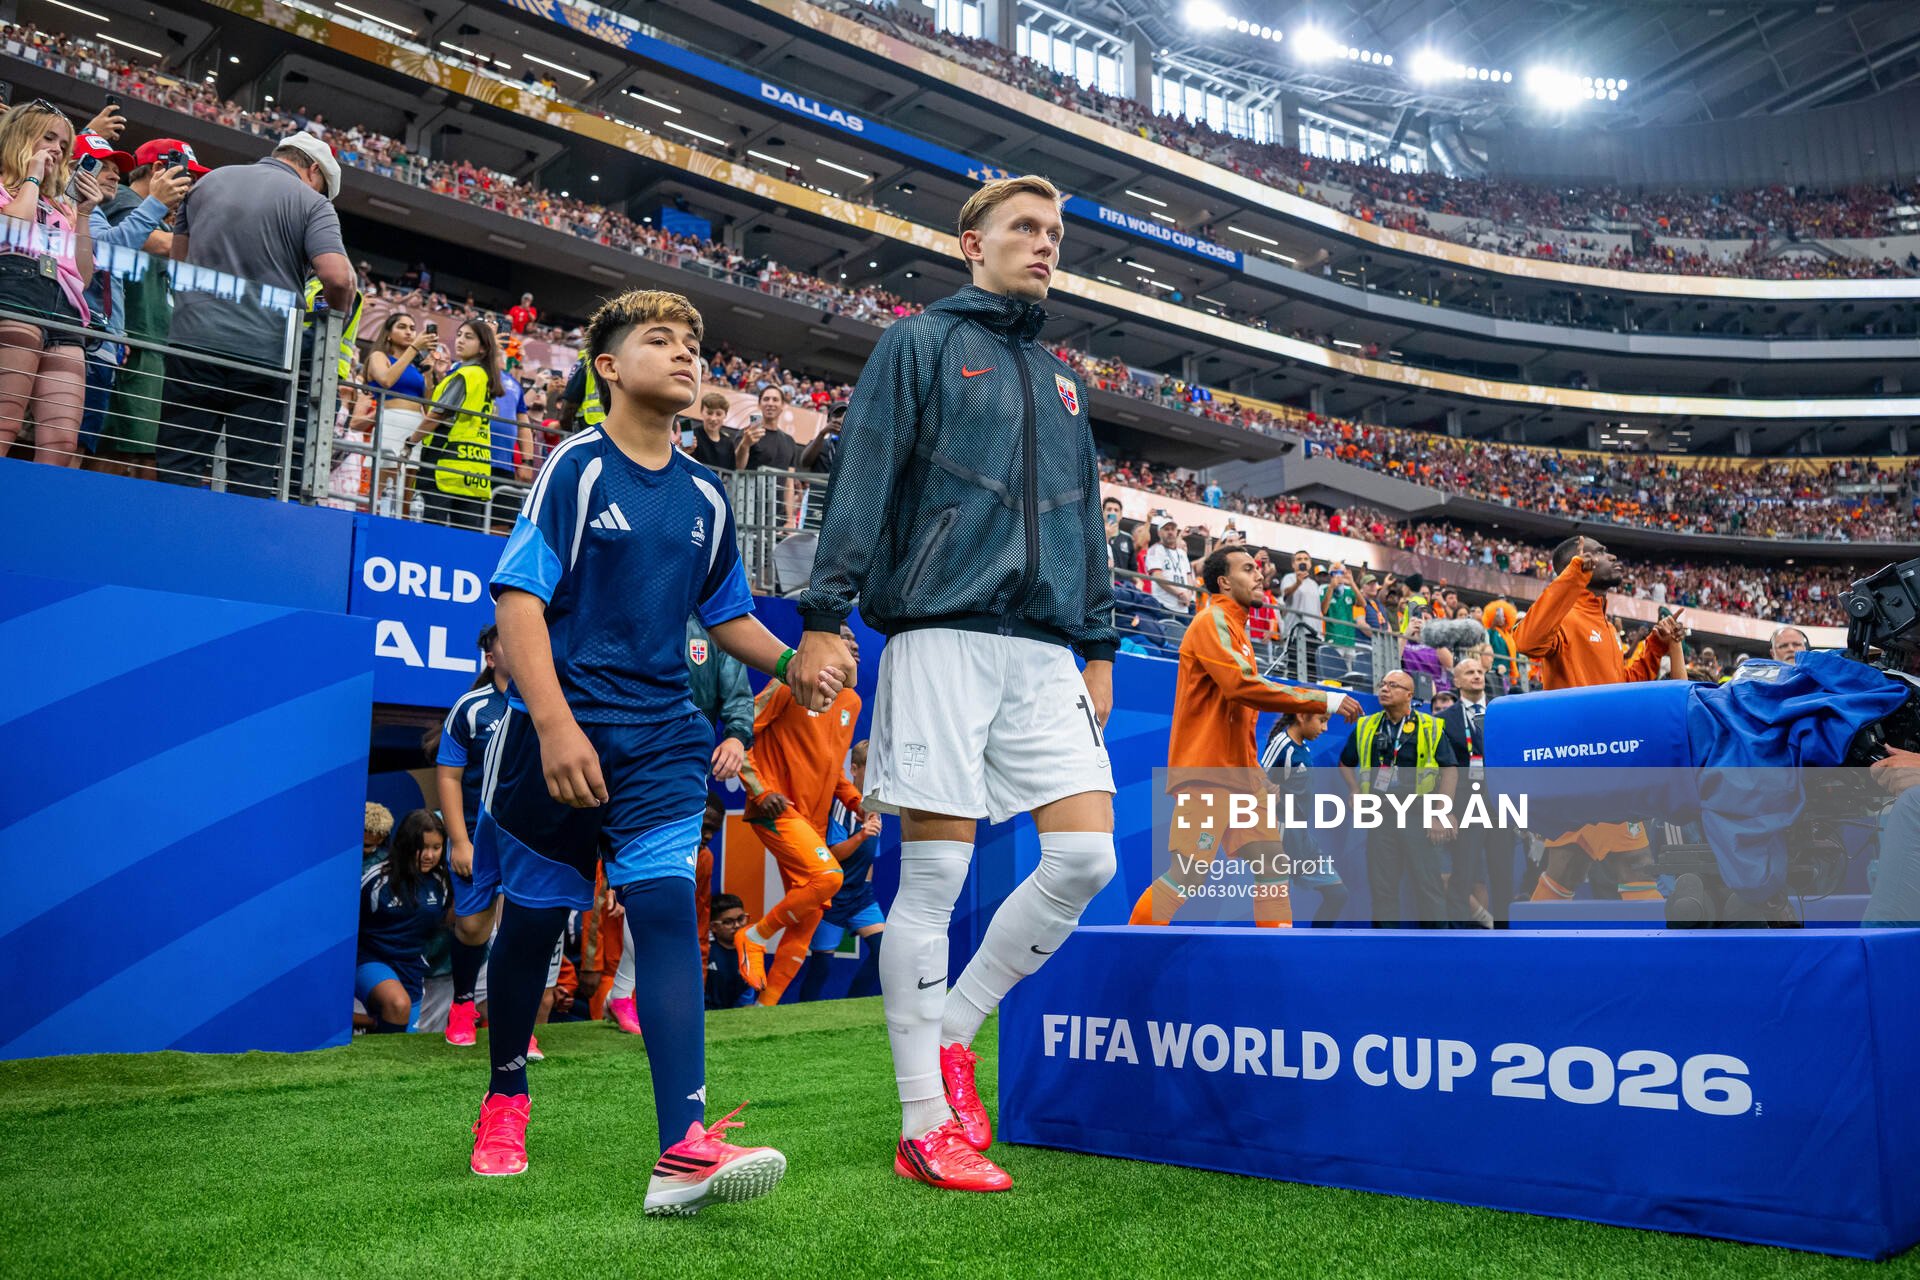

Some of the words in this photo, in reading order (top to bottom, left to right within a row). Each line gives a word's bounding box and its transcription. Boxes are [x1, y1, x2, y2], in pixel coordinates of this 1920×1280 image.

[761, 83, 864, 132] DALLAS
[1099, 206, 1127, 227] FIFA
[1127, 216, 1171, 241] WORLD
[1172, 232, 1196, 249] CUP
[1196, 239, 1236, 263] 2026
[363, 556, 482, 604] ORLD
[374, 619, 487, 673] AL
[1076, 694, 1108, 749] 1
[1523, 747, 1554, 762] FIFA
[1555, 742, 1608, 758] WORLD
[1610, 740, 1640, 754] CUP
[1043, 1014, 1140, 1064] FIFA
[1147, 1020, 1341, 1081] WORLD
[1353, 1033, 1477, 1093] CUP
[1490, 1042, 1753, 1116] 2026
